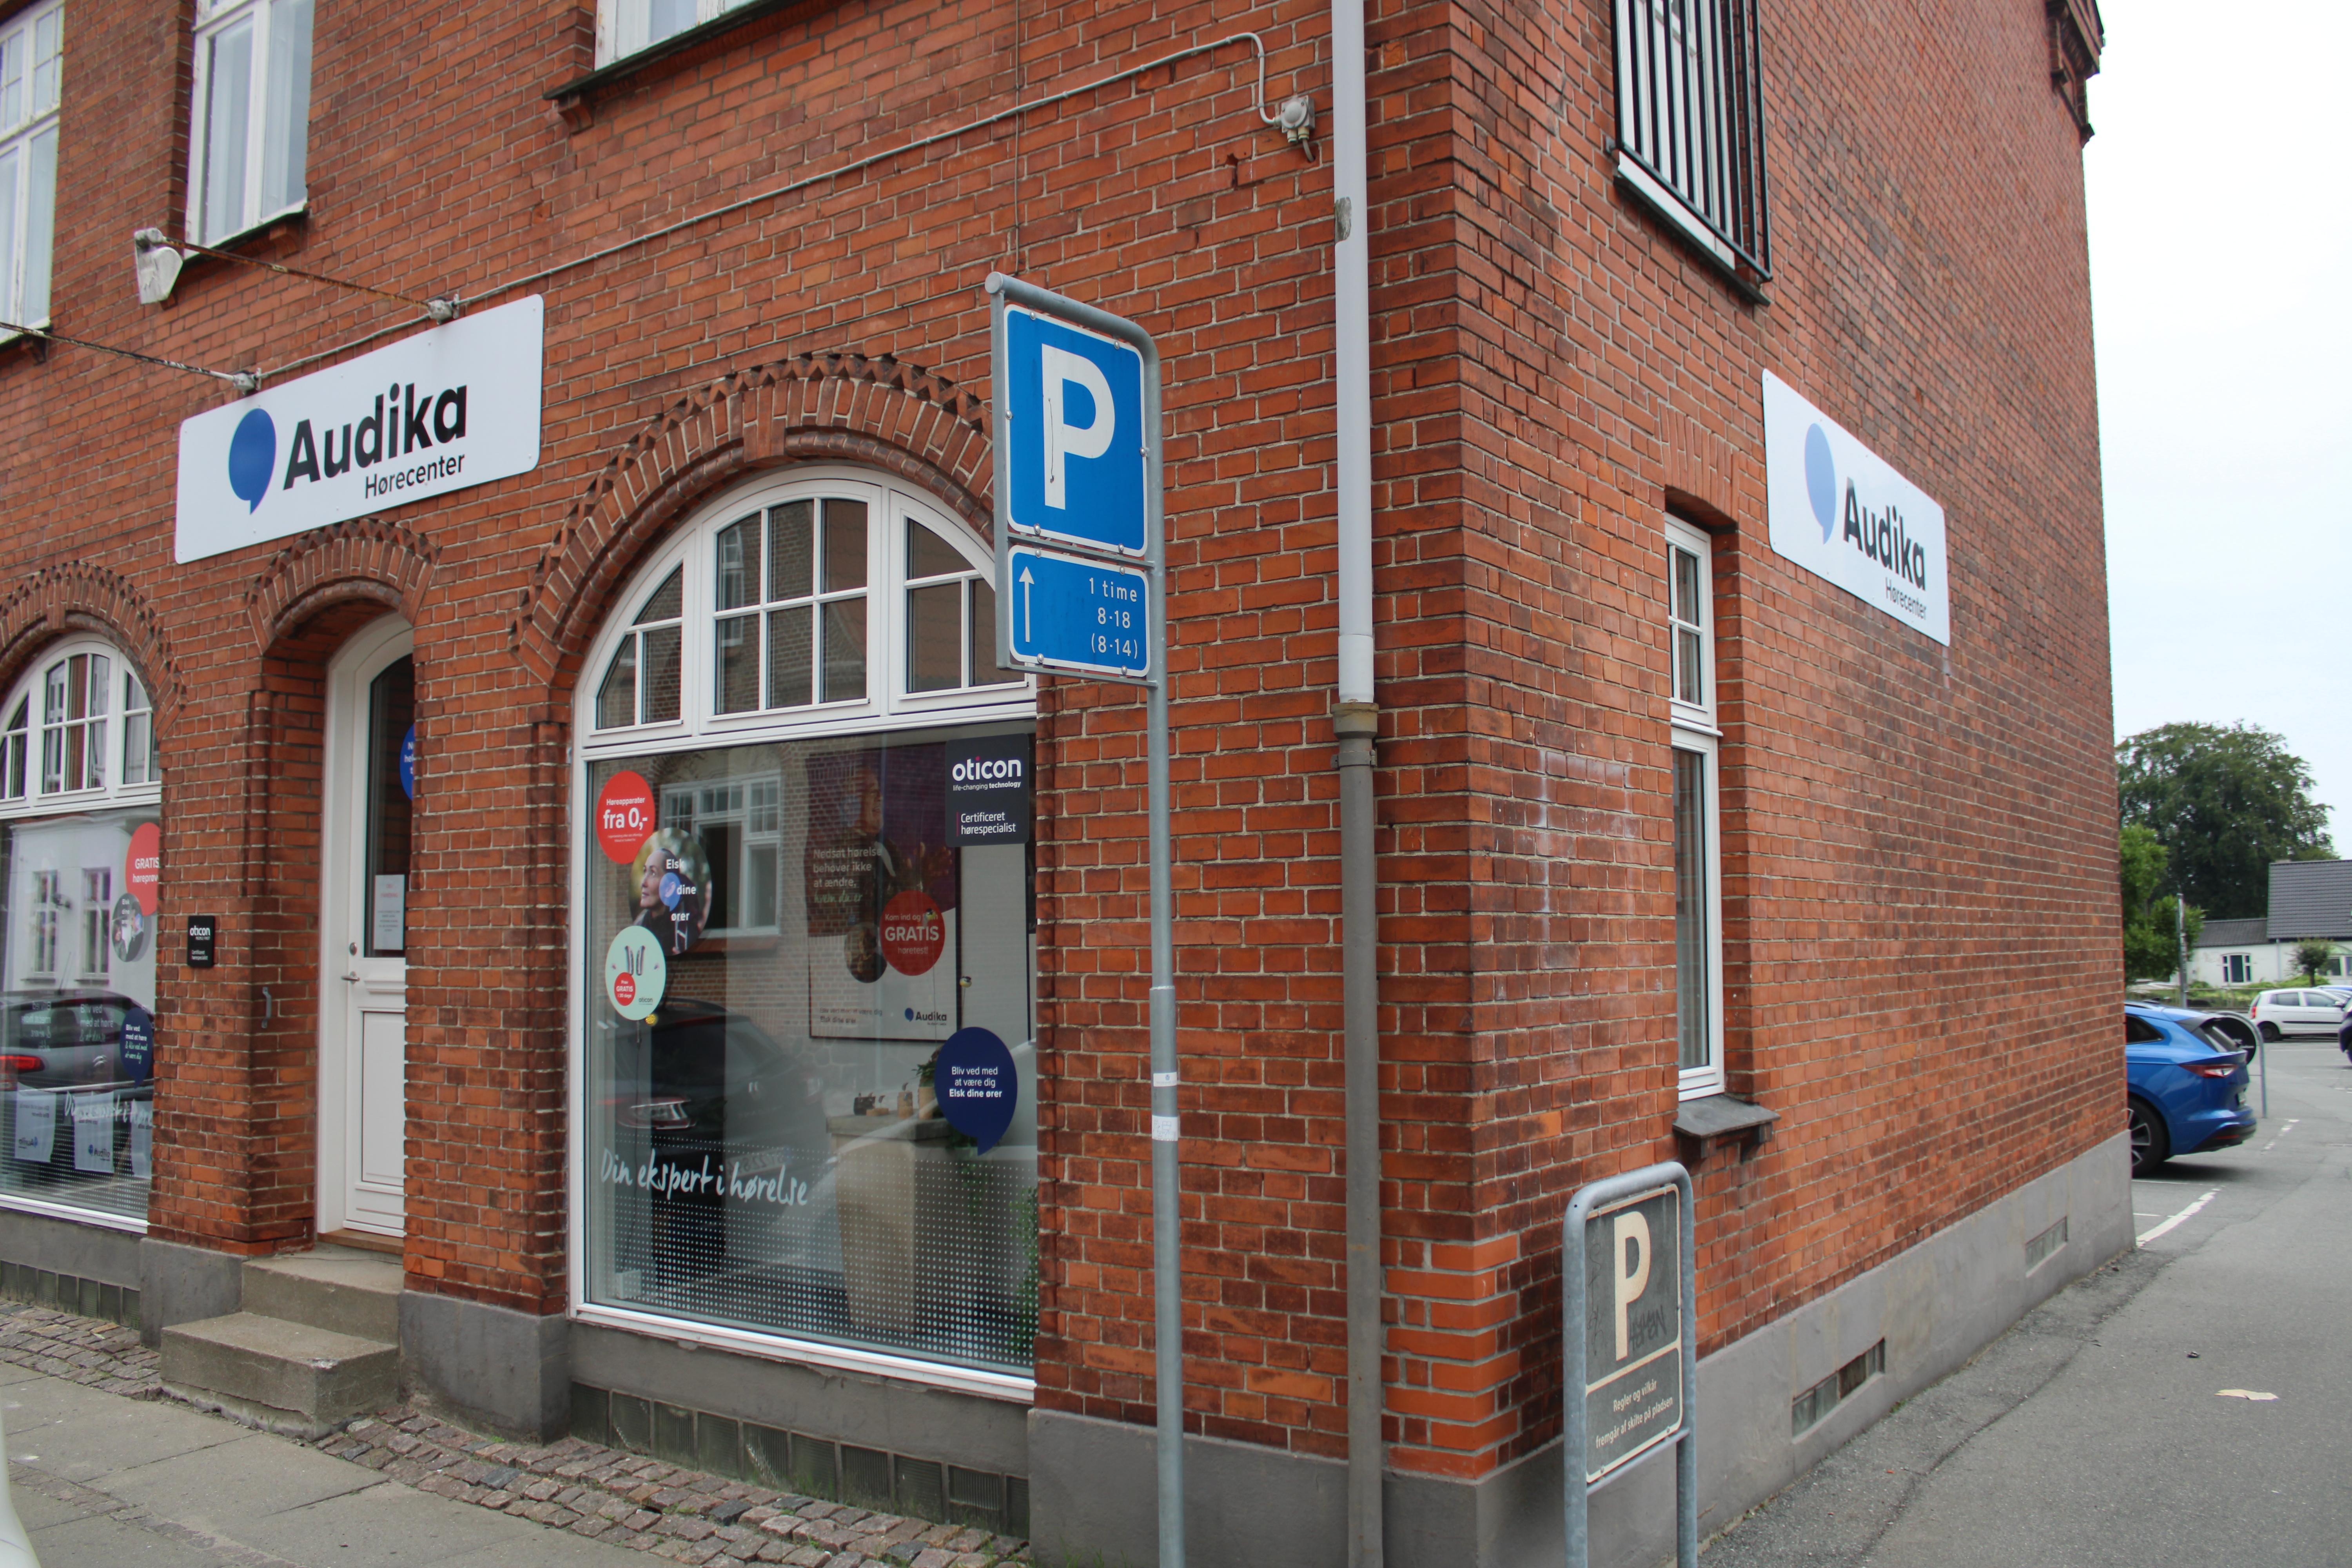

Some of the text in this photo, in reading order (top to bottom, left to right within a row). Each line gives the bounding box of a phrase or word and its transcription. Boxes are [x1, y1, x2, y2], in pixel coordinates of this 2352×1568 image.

[1042, 343, 1115, 510] P
[283, 383, 467, 490] Audika
[365, 454, 465, 499] Hørecenter
[1843, 476, 1926, 591] Audika
[1089, 577, 1137, 602] 1 time
[1885, 577, 1926, 620] Hørecenter
[952, 756, 1021, 781] oticon
[606, 797, 645, 806] Høreapparater
[603, 807, 648, 830] fra 0,-
[961, 812, 1005, 823] Certificeret
[961, 823, 1016, 835] hørespecialist
[813, 847, 882, 859] Nedsat hørelse
[135, 857, 159, 869] GRATIS
[666, 858, 684, 869] Elsk
[852, 862, 872, 871] ikke
[814, 878, 822, 887] at
[677, 884, 697, 895] dine
[671, 912, 690, 921] ører
[189, 925, 211, 936] oticon
[885, 926, 939, 941] GRATIS
[915, 1011, 947, 1021] Audika
[952, 1066, 998, 1075] Bliv ved med
[984, 1078, 996, 1088] dig
[949, 1089, 965, 1097] Elsk
[967, 1089, 984, 1097] dine
[600, 1147, 633, 1187] Din
[637, 1148, 714, 1200] ekspert
[716, 1165, 725, 1195] i
[730, 1161, 808, 1206] hørelse
[1614, 1211, 1651, 1361] P
[1613, 1379, 1657, 1412] Regler og vilkår
[1596, 1397, 1673, 1448] fremgår af skilte på pladsen
